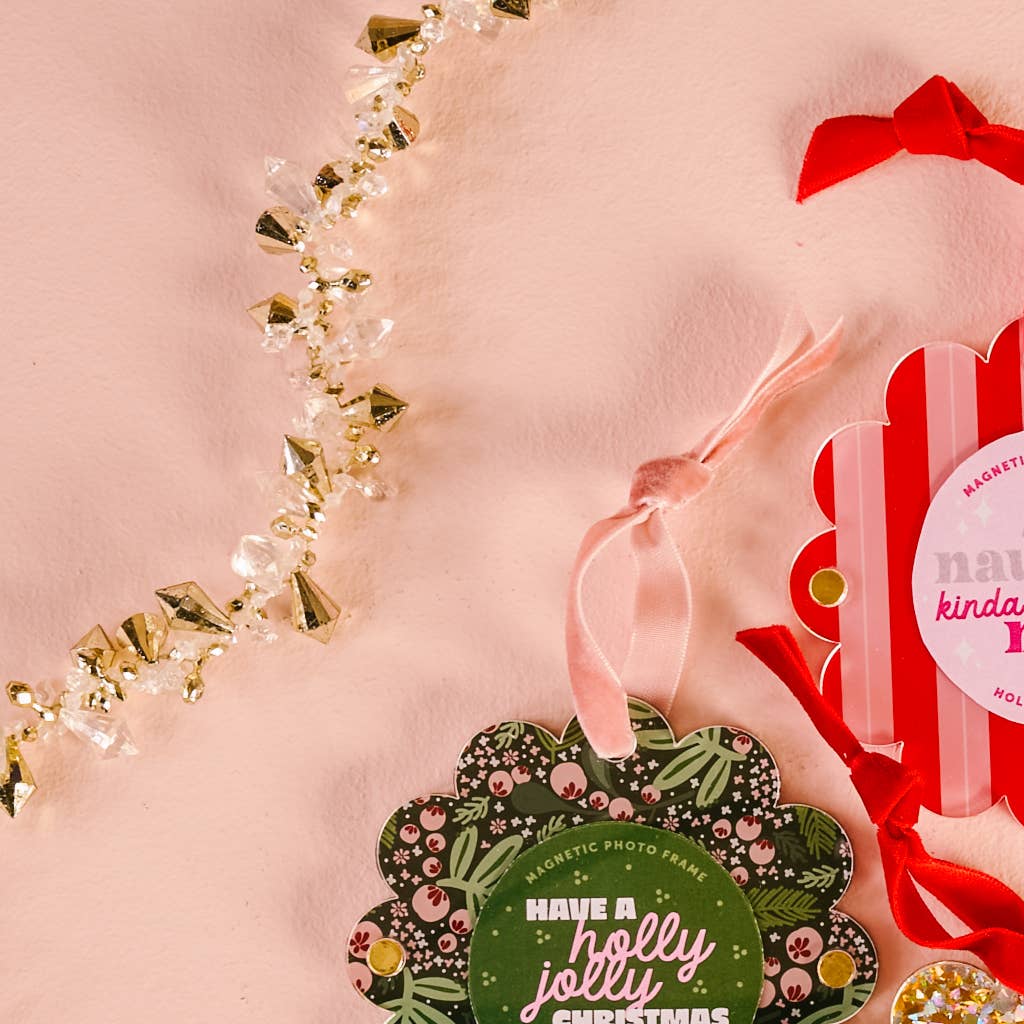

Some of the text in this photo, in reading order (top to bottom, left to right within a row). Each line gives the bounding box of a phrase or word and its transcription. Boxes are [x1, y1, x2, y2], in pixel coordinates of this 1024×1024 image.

[525, 840, 708, 884] MAGNETIC PHOTO FRAME
[526, 897, 637, 921] HAVE A
[568, 912, 716, 983] holly
[520, 951, 663, 1024] jolly
